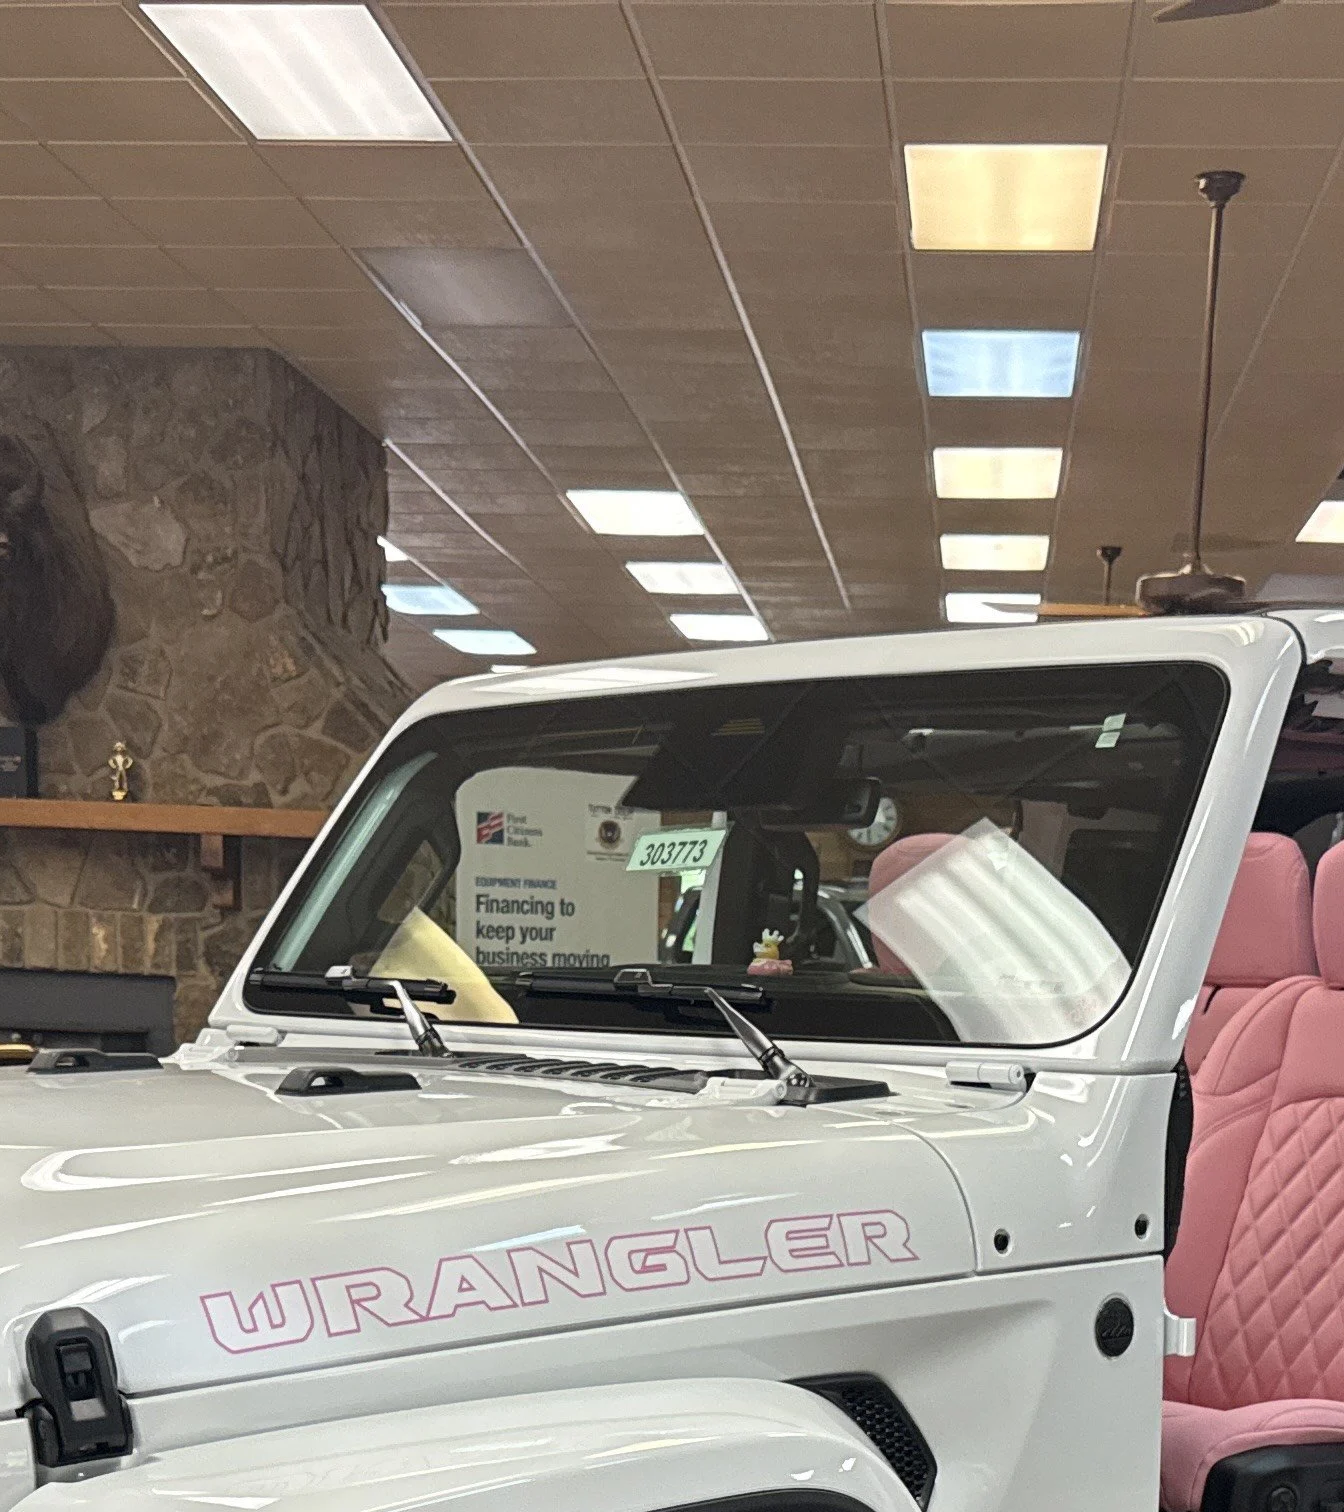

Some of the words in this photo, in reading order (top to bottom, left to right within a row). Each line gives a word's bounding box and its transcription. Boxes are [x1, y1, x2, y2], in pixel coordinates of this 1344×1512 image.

[639, 839, 708, 867] 303773
[475, 894, 555, 920] Financing
[559, 898, 576, 917] to
[475, 922, 516, 944] keep
[520, 927, 556, 945] your
[475, 947, 548, 968] business
[552, 950, 611, 968] moving
[200, 1209, 920, 1355] WRANGLER
